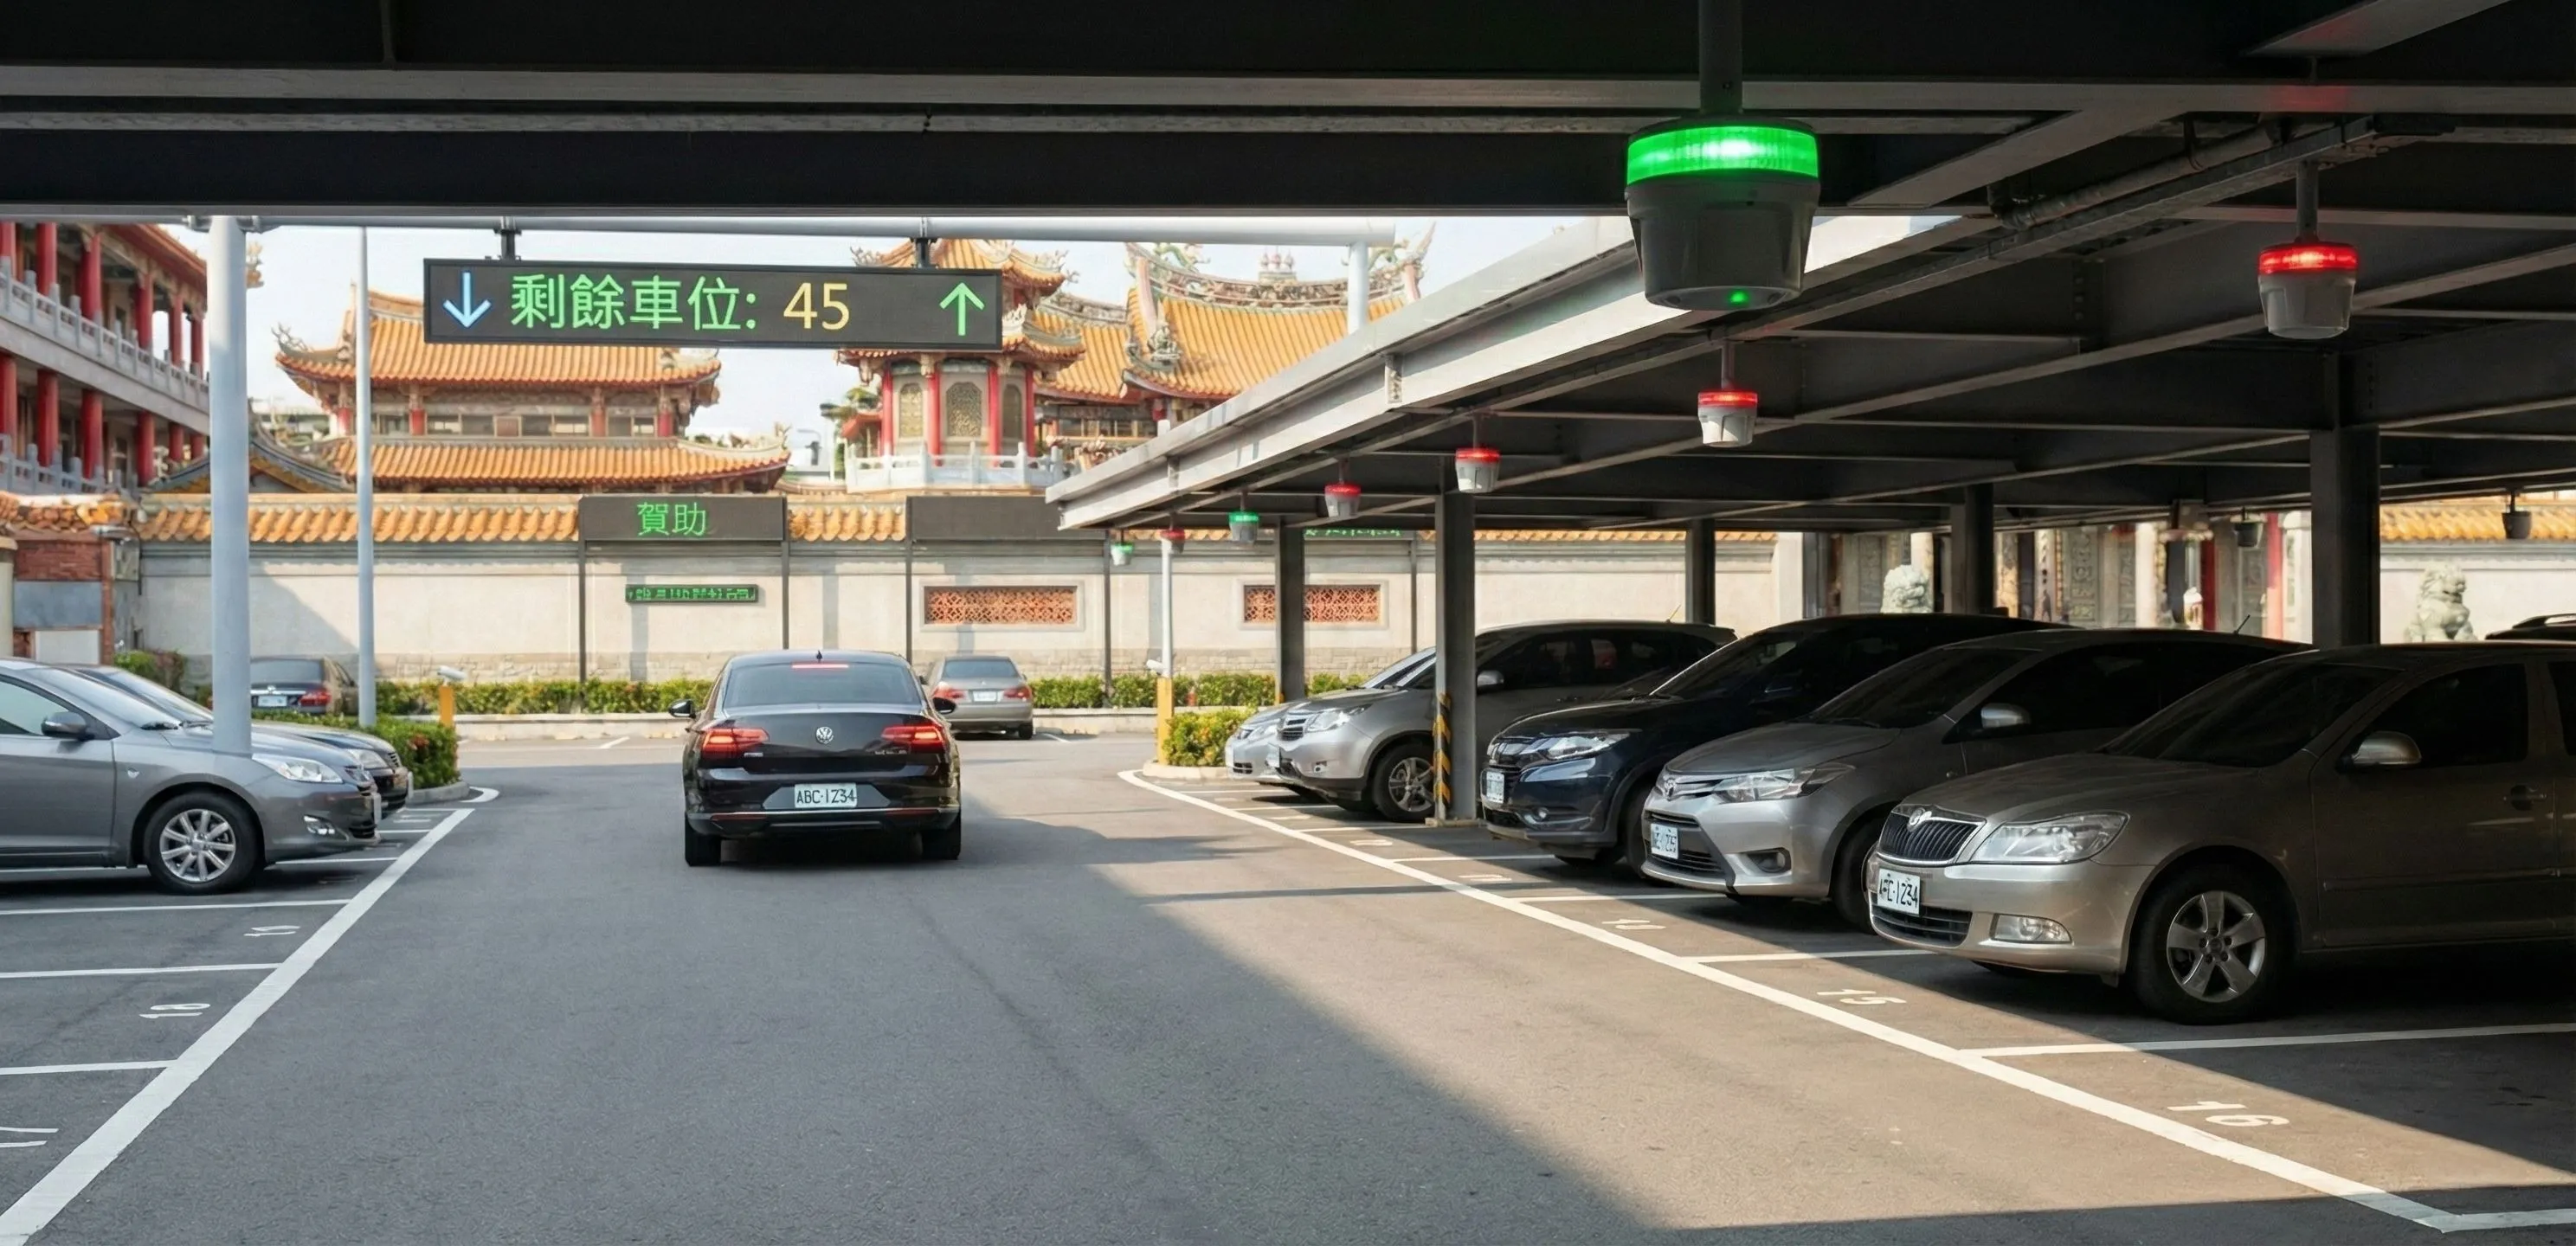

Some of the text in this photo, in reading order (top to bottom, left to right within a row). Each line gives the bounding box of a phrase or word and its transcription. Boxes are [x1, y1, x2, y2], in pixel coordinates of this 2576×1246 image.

[511, 273, 849, 331] 剩餘車位: 45
[1817, 988, 1907, 1005] 15
[2167, 1101, 2290, 1127] 16
